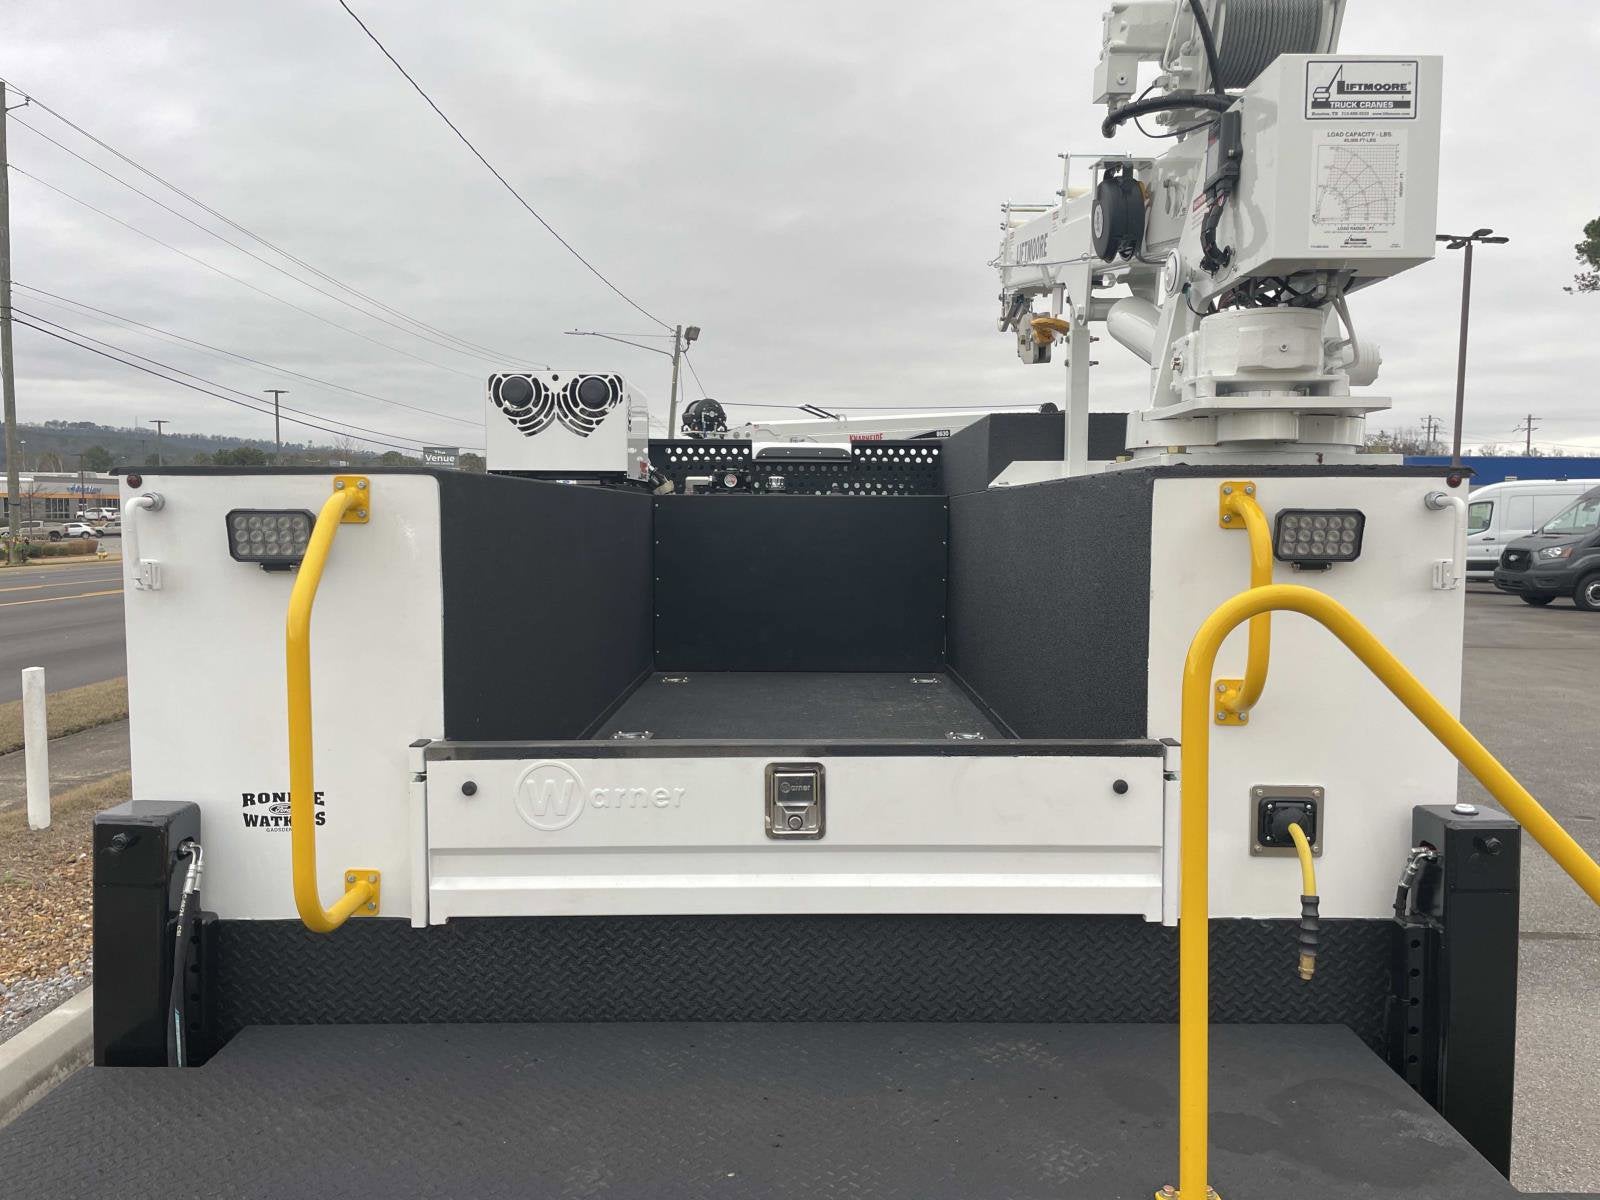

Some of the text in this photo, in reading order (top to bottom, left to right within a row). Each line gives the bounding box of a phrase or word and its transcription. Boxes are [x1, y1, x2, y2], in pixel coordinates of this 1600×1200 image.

[1330, 101, 1394, 109] TRUCK CRANES
[1017, 232, 1049, 265] LIFTMOORE
[242, 791, 324, 807] RONE
[521, 772, 686, 818] Warner
[243, 812, 325, 827] WATKS
